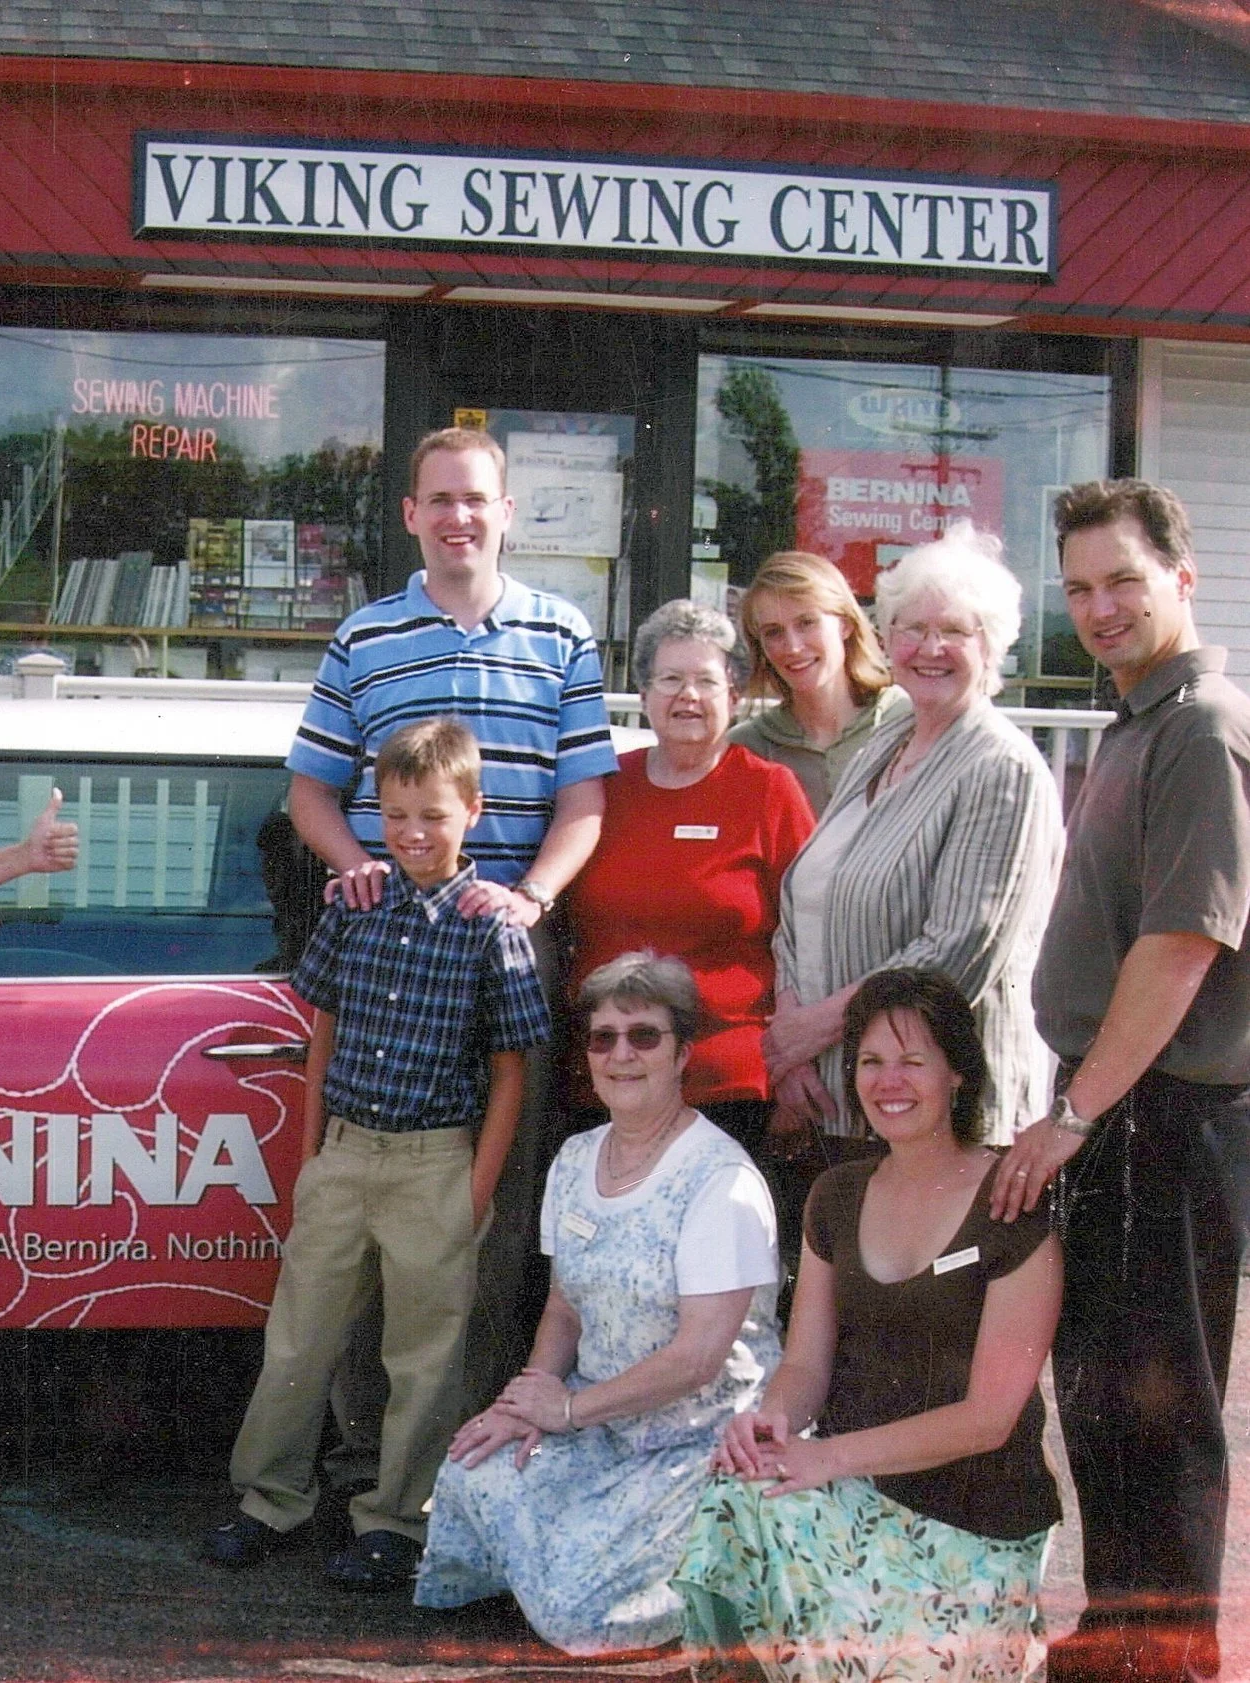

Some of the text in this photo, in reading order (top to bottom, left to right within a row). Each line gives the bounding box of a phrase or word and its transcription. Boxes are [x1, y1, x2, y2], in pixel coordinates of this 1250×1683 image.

[151, 153, 1044, 266] VIKING SEWING CENTER
[71, 377, 281, 419] SEWING MACHINE
[131, 423, 218, 462] REPAIR
[826, 475, 972, 507] BERNINA
[828, 504, 902, 534] Sewing
[23, 1231, 157, 1261] Bernina.
[167, 1230, 278, 1261] Nothin
